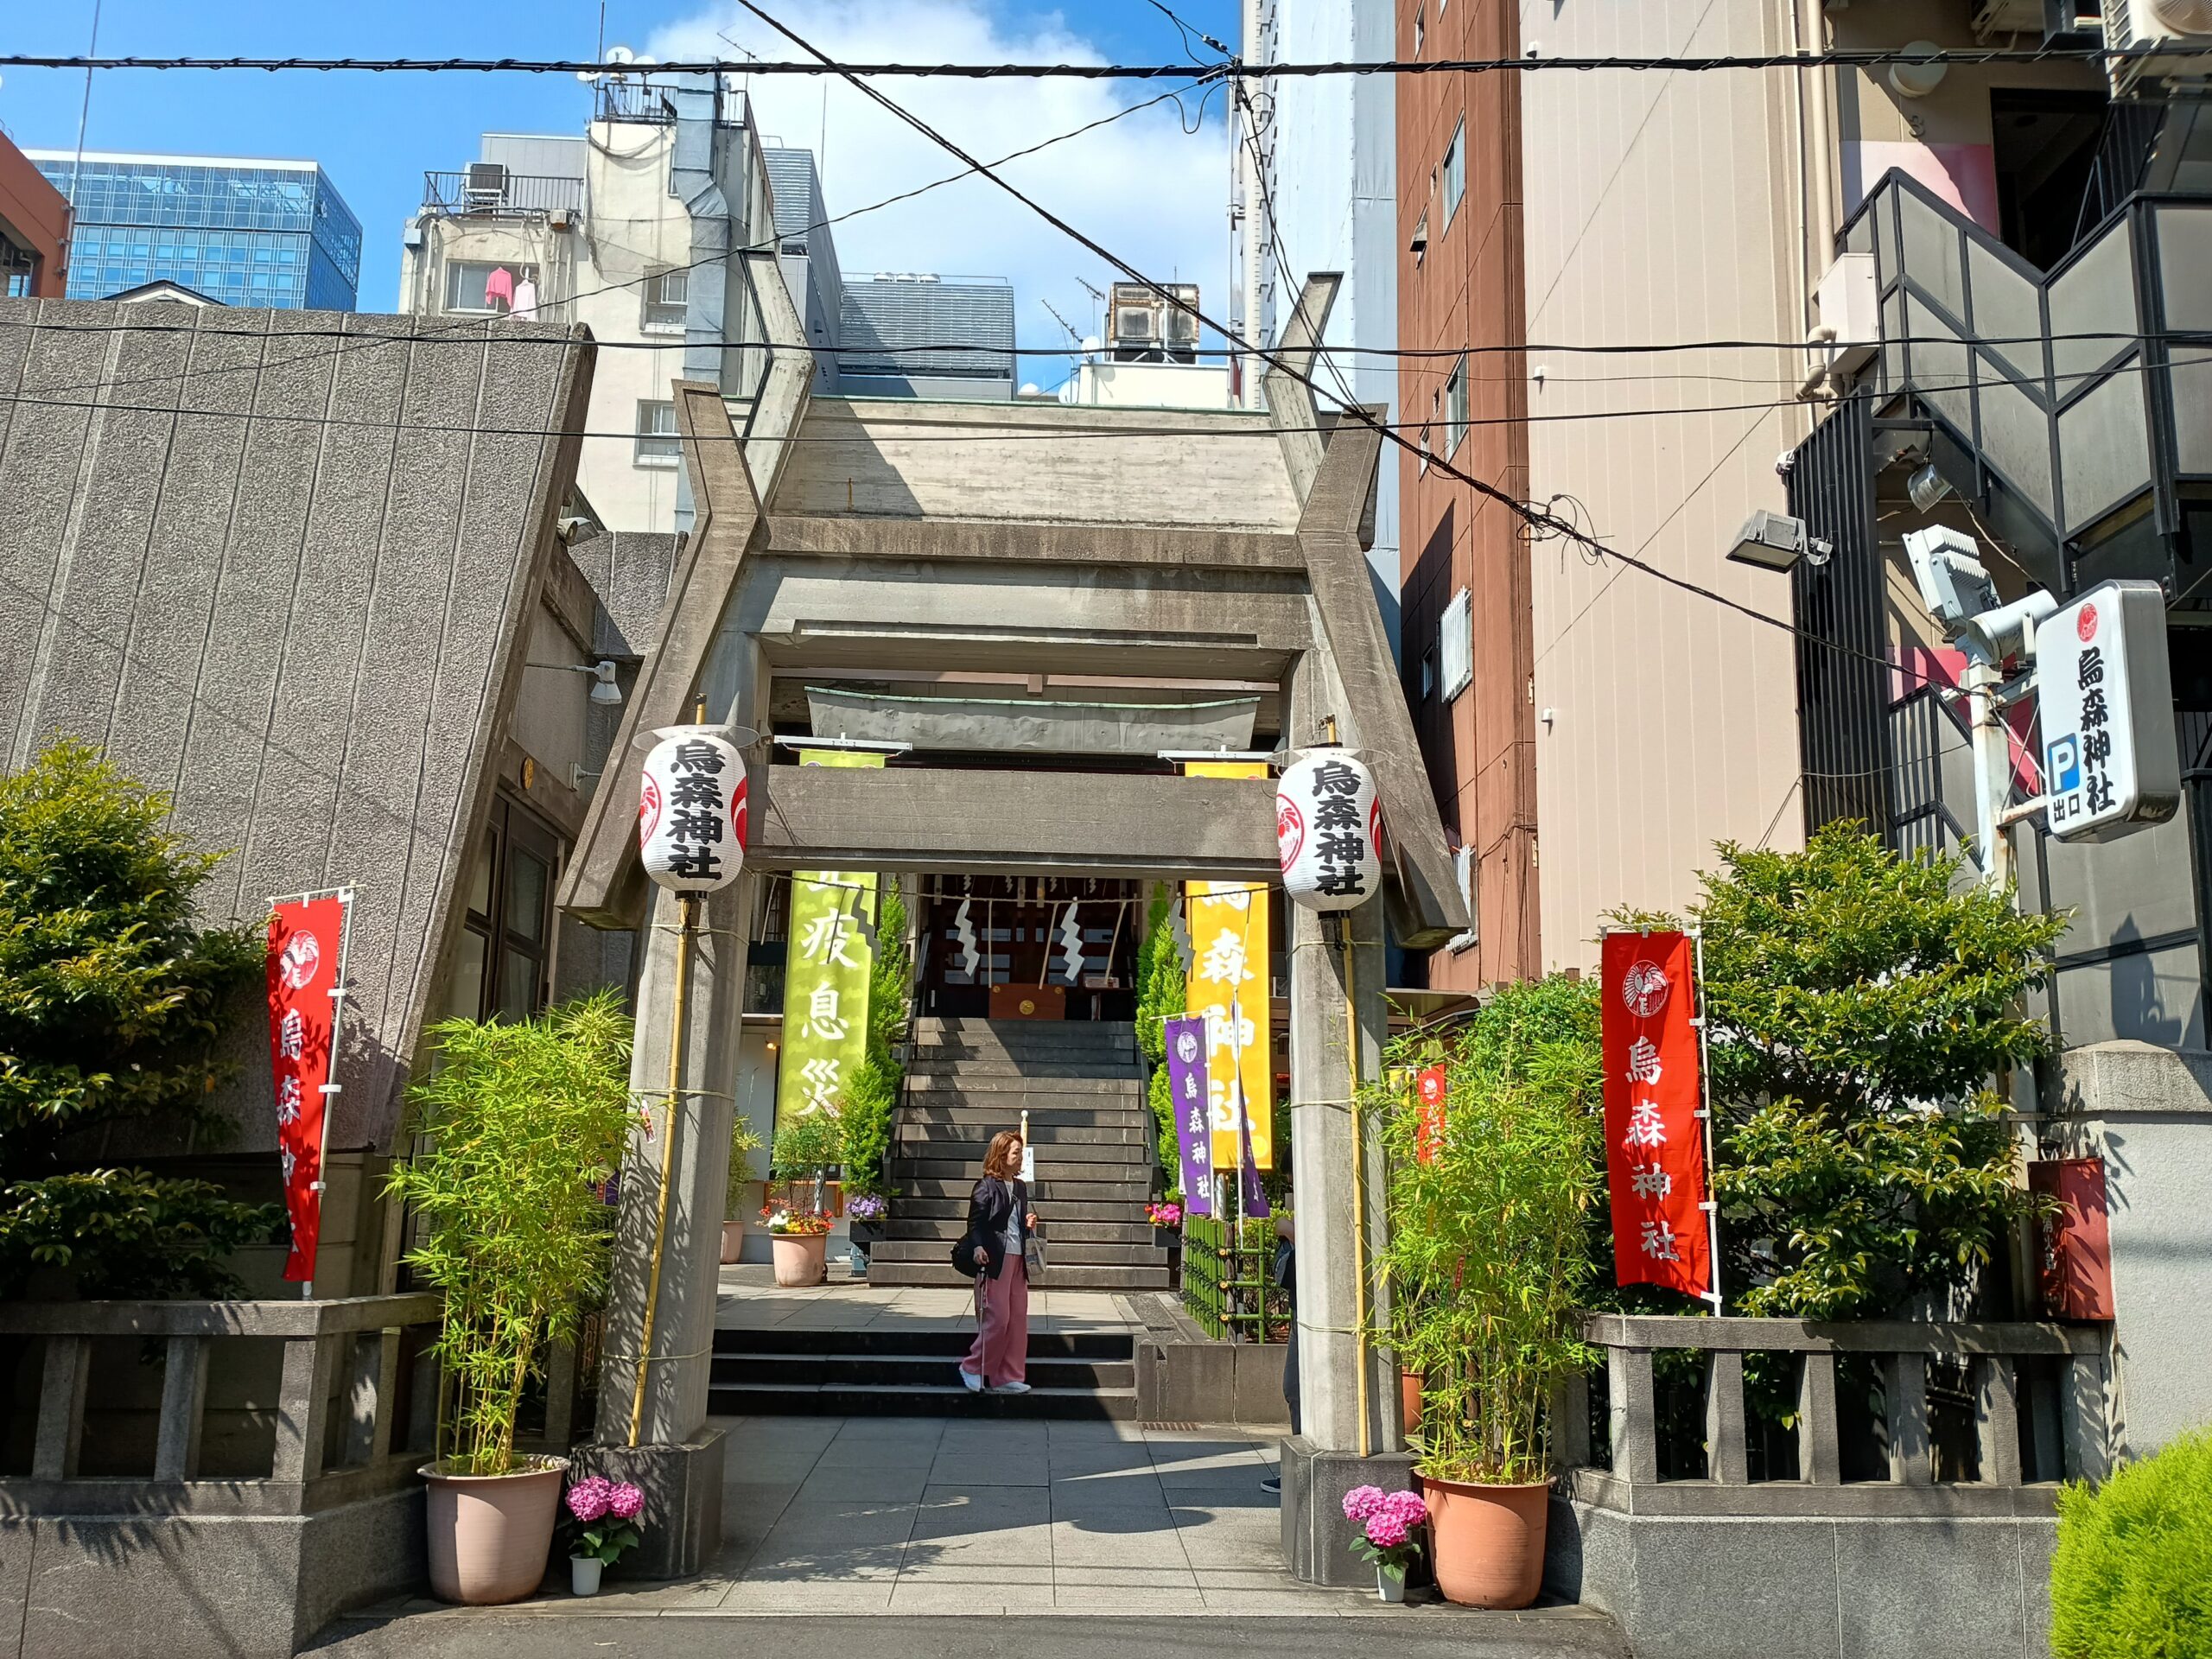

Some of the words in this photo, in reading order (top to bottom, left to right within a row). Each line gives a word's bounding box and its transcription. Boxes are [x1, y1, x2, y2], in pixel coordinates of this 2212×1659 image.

[2050, 741, 2075, 792] P
[2077, 645, 2116, 817] 烏森神社
[666, 739, 726, 880] 烏森神社
[1312, 760, 1366, 896] 烏森神社
[2053, 794, 2081, 823] 出口
[276, 1007, 303, 1253] 烏森神
[1185, 1072, 1210, 1198] 烏森神社
[1624, 1035, 1680, 1262] 烏森神社
